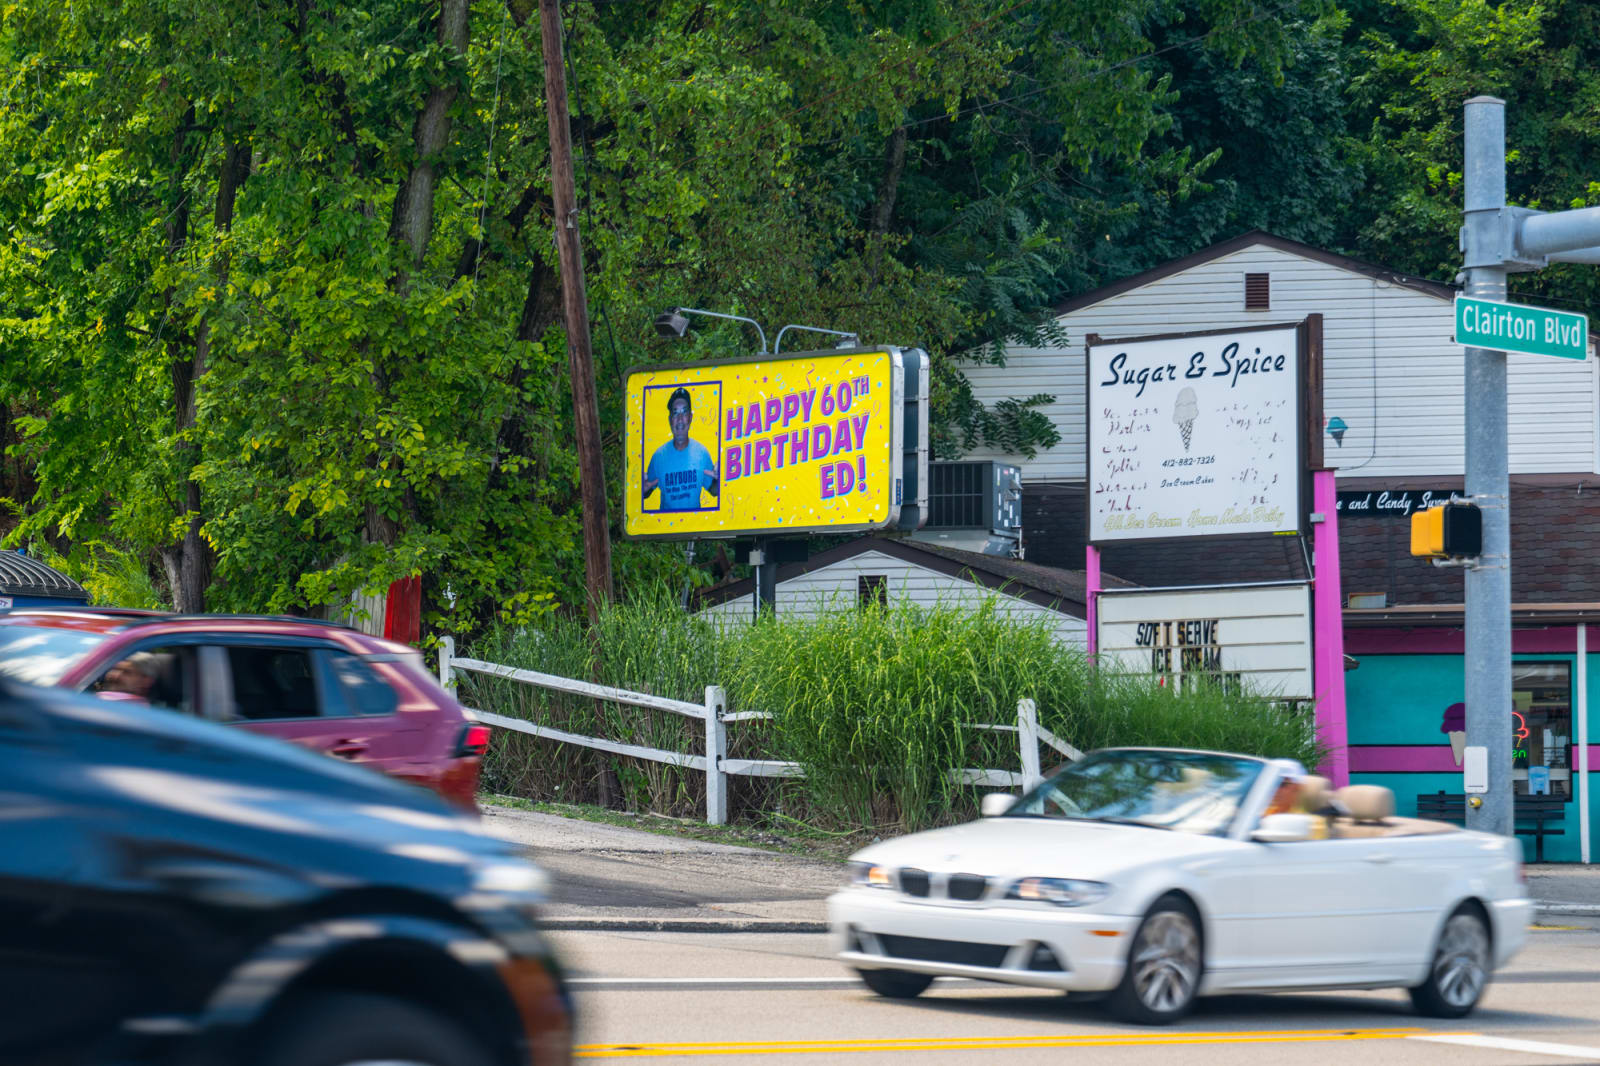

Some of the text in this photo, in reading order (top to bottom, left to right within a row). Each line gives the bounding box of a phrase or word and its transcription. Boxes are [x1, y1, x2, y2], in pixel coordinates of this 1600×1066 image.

[1462, 305, 1581, 348] Clairton Blvd
[1100, 342, 1286, 398] Sugar & Spice
[725, 374, 870, 441] HAPPY 60TH
[724, 413, 871, 482] BIRTHDAY
[1161, 455, 1216, 468] 412-882-7326
[820, 454, 869, 500] ED!
[1348, 492, 1373, 510] and
[1376, 490, 1413, 516] Candy
[1135, 619, 1219, 646] SOFT SERVE
[1151, 646, 1222, 673] ICE CREAM
[1512, 749, 1527, 759] en
